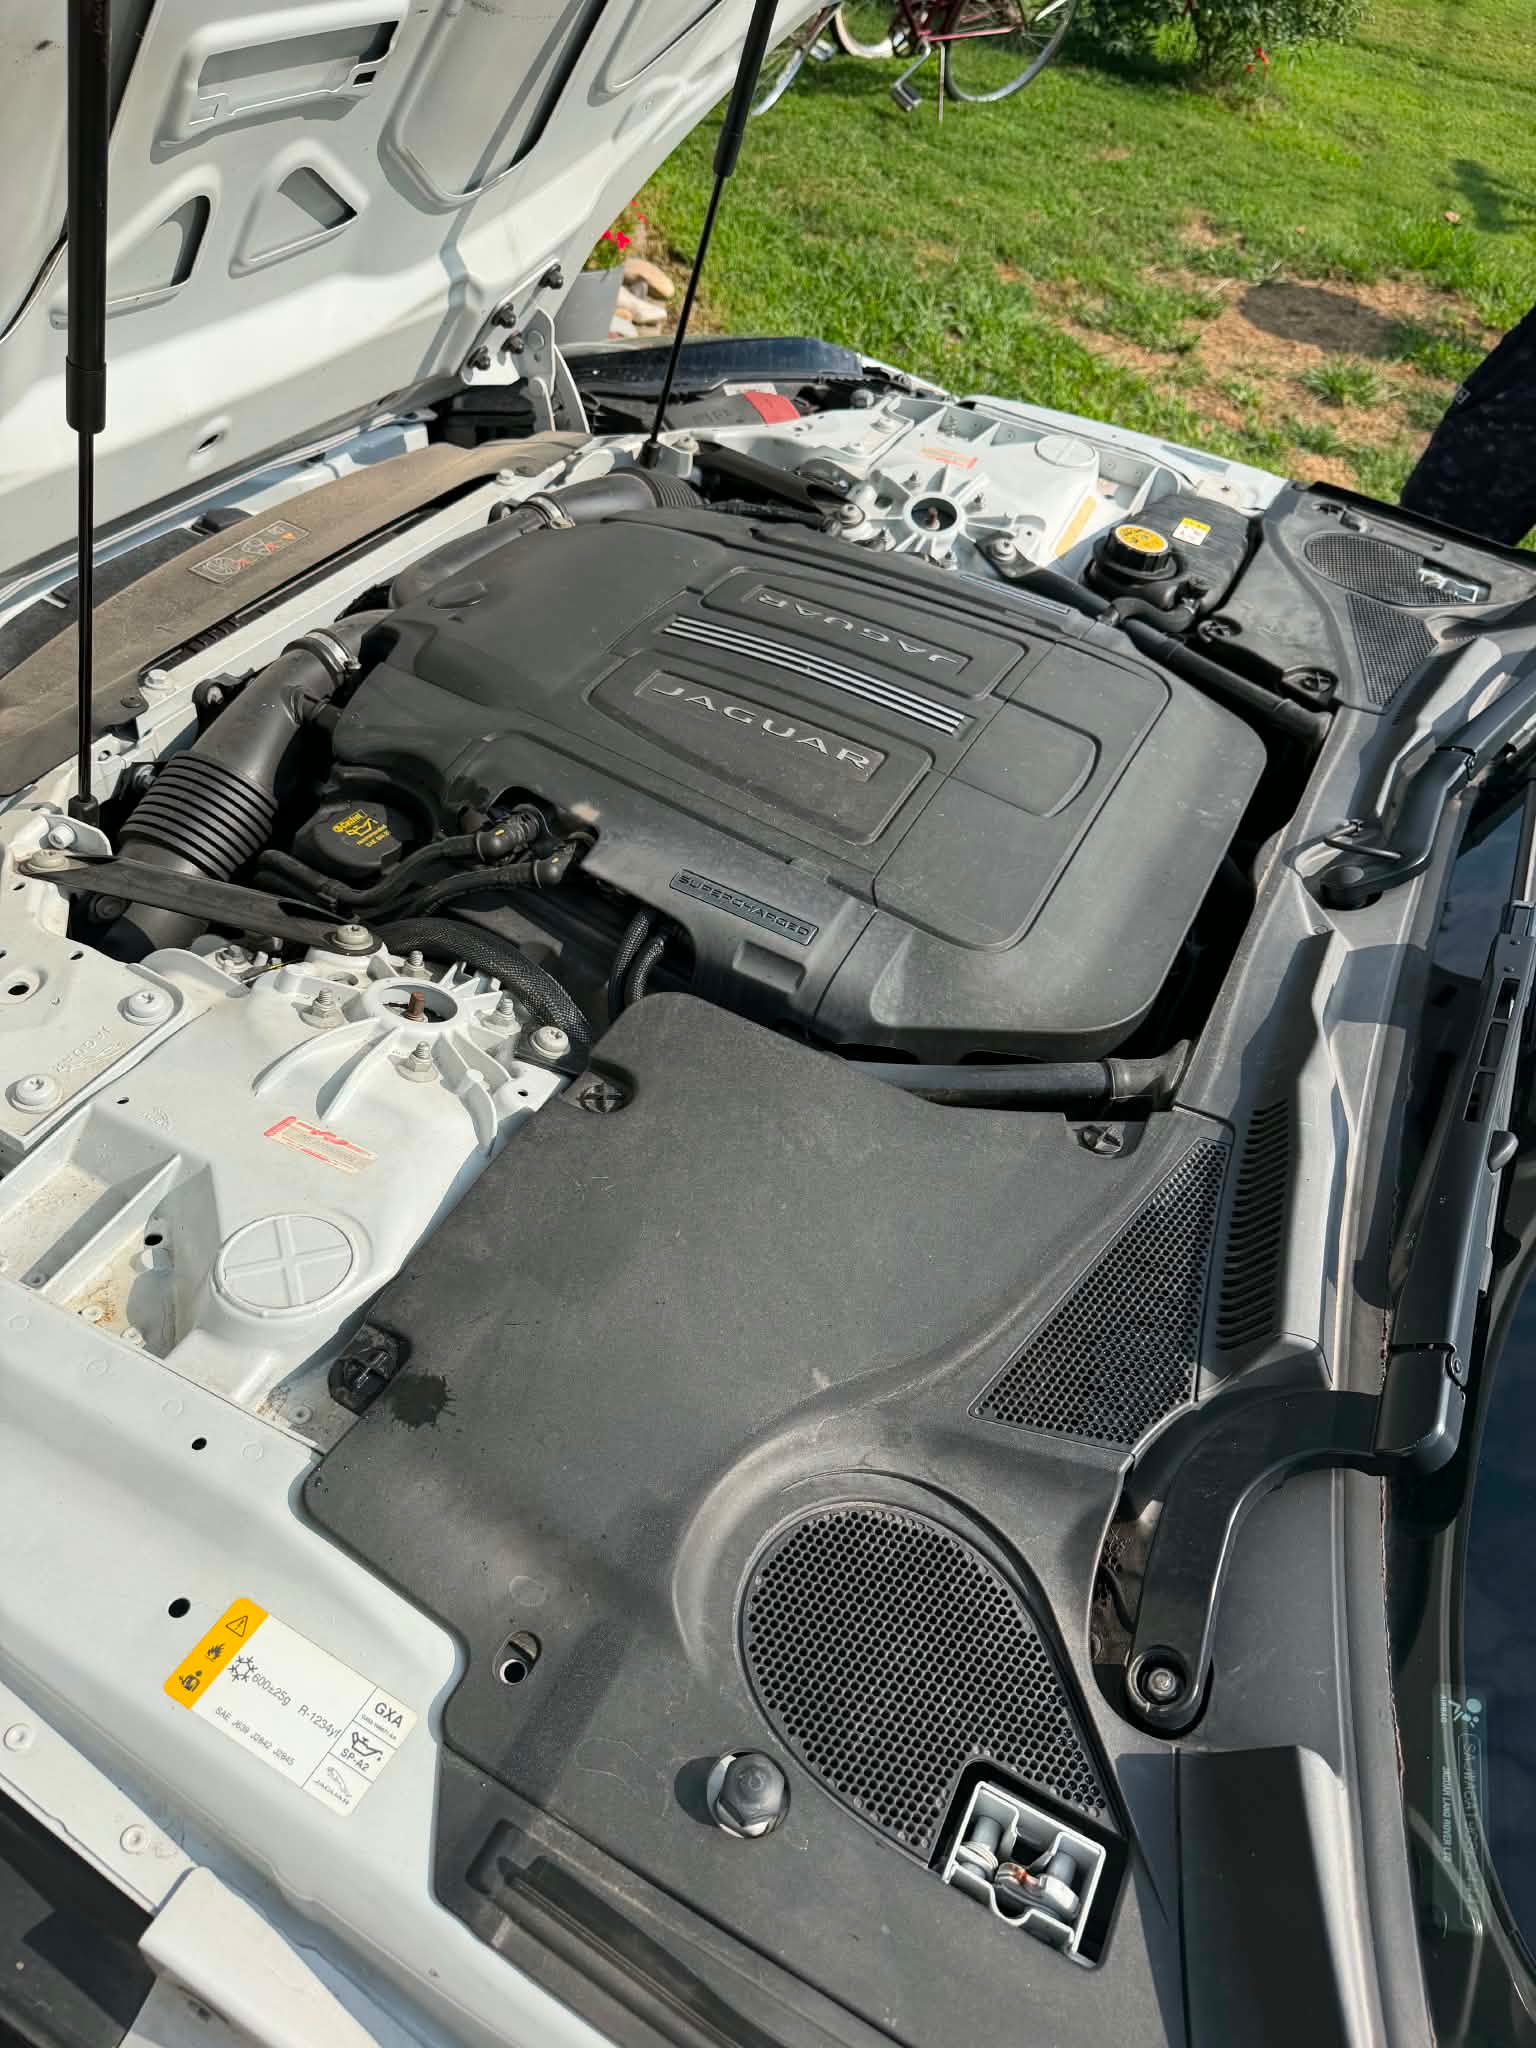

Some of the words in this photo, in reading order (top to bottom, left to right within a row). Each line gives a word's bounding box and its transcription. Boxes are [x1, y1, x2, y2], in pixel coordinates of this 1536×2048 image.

[759, 594, 958, 663] JAGUAR
[652, 687, 870, 770] JAGUAR
[678, 875, 809, 936] SUPERCHARGED
[215, 1706, 232, 1722] SAE
[251, 1673, 292, 1706] 600±25g
[297, 1704, 343, 1739] R-1234yf
[375, 1702, 404, 1729] GXA
[340, 1748, 370, 1772] SP-A2
